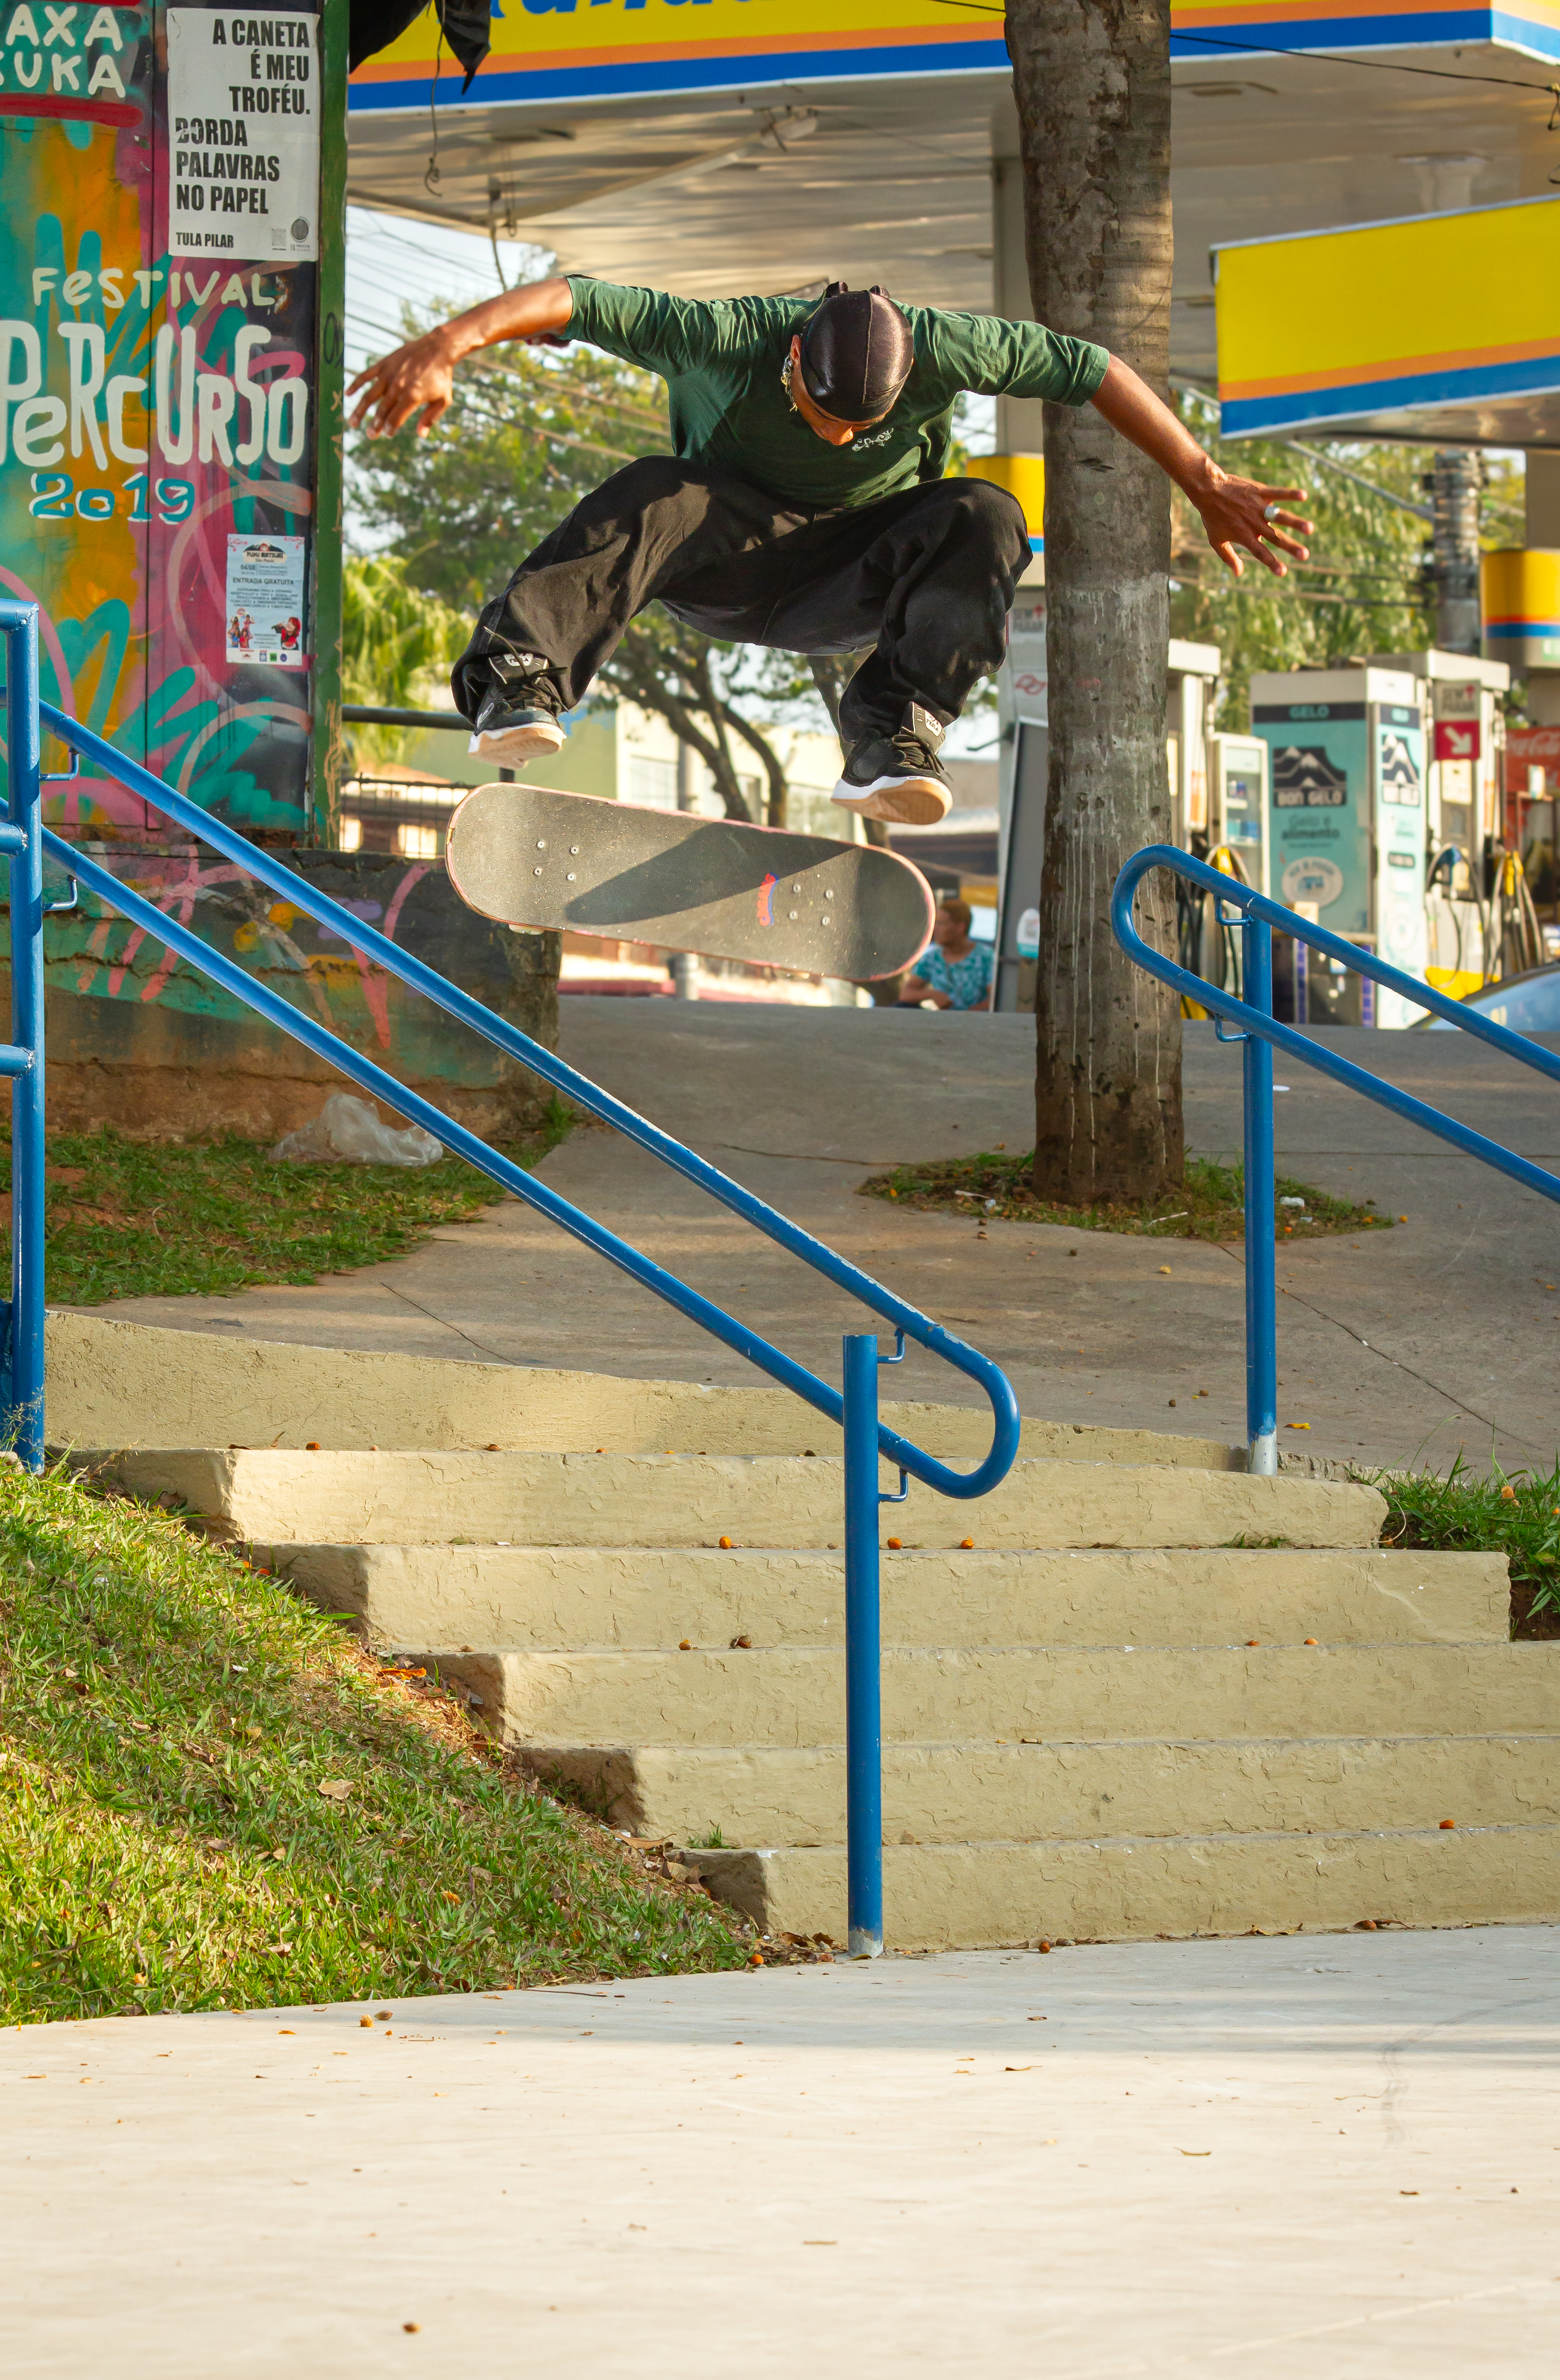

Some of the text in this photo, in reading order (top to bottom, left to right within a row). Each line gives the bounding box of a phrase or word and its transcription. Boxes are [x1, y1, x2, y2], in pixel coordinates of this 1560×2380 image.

[213, 19, 310, 48] A CANETA
[0, 51, 126, 98] UKA
[250, 49, 309, 82] É MEU
[229, 83, 310, 115] TROFÉU.
[175, 117, 247, 146] BORDA
[176, 151, 280, 181] PALAVRAS
[176, 184, 269, 214] NO PAPEL
[176, 232, 234, 248] TULA PILAR
[29, 472, 195, 524] 2019
[1290, 706, 1329, 719] GELO
